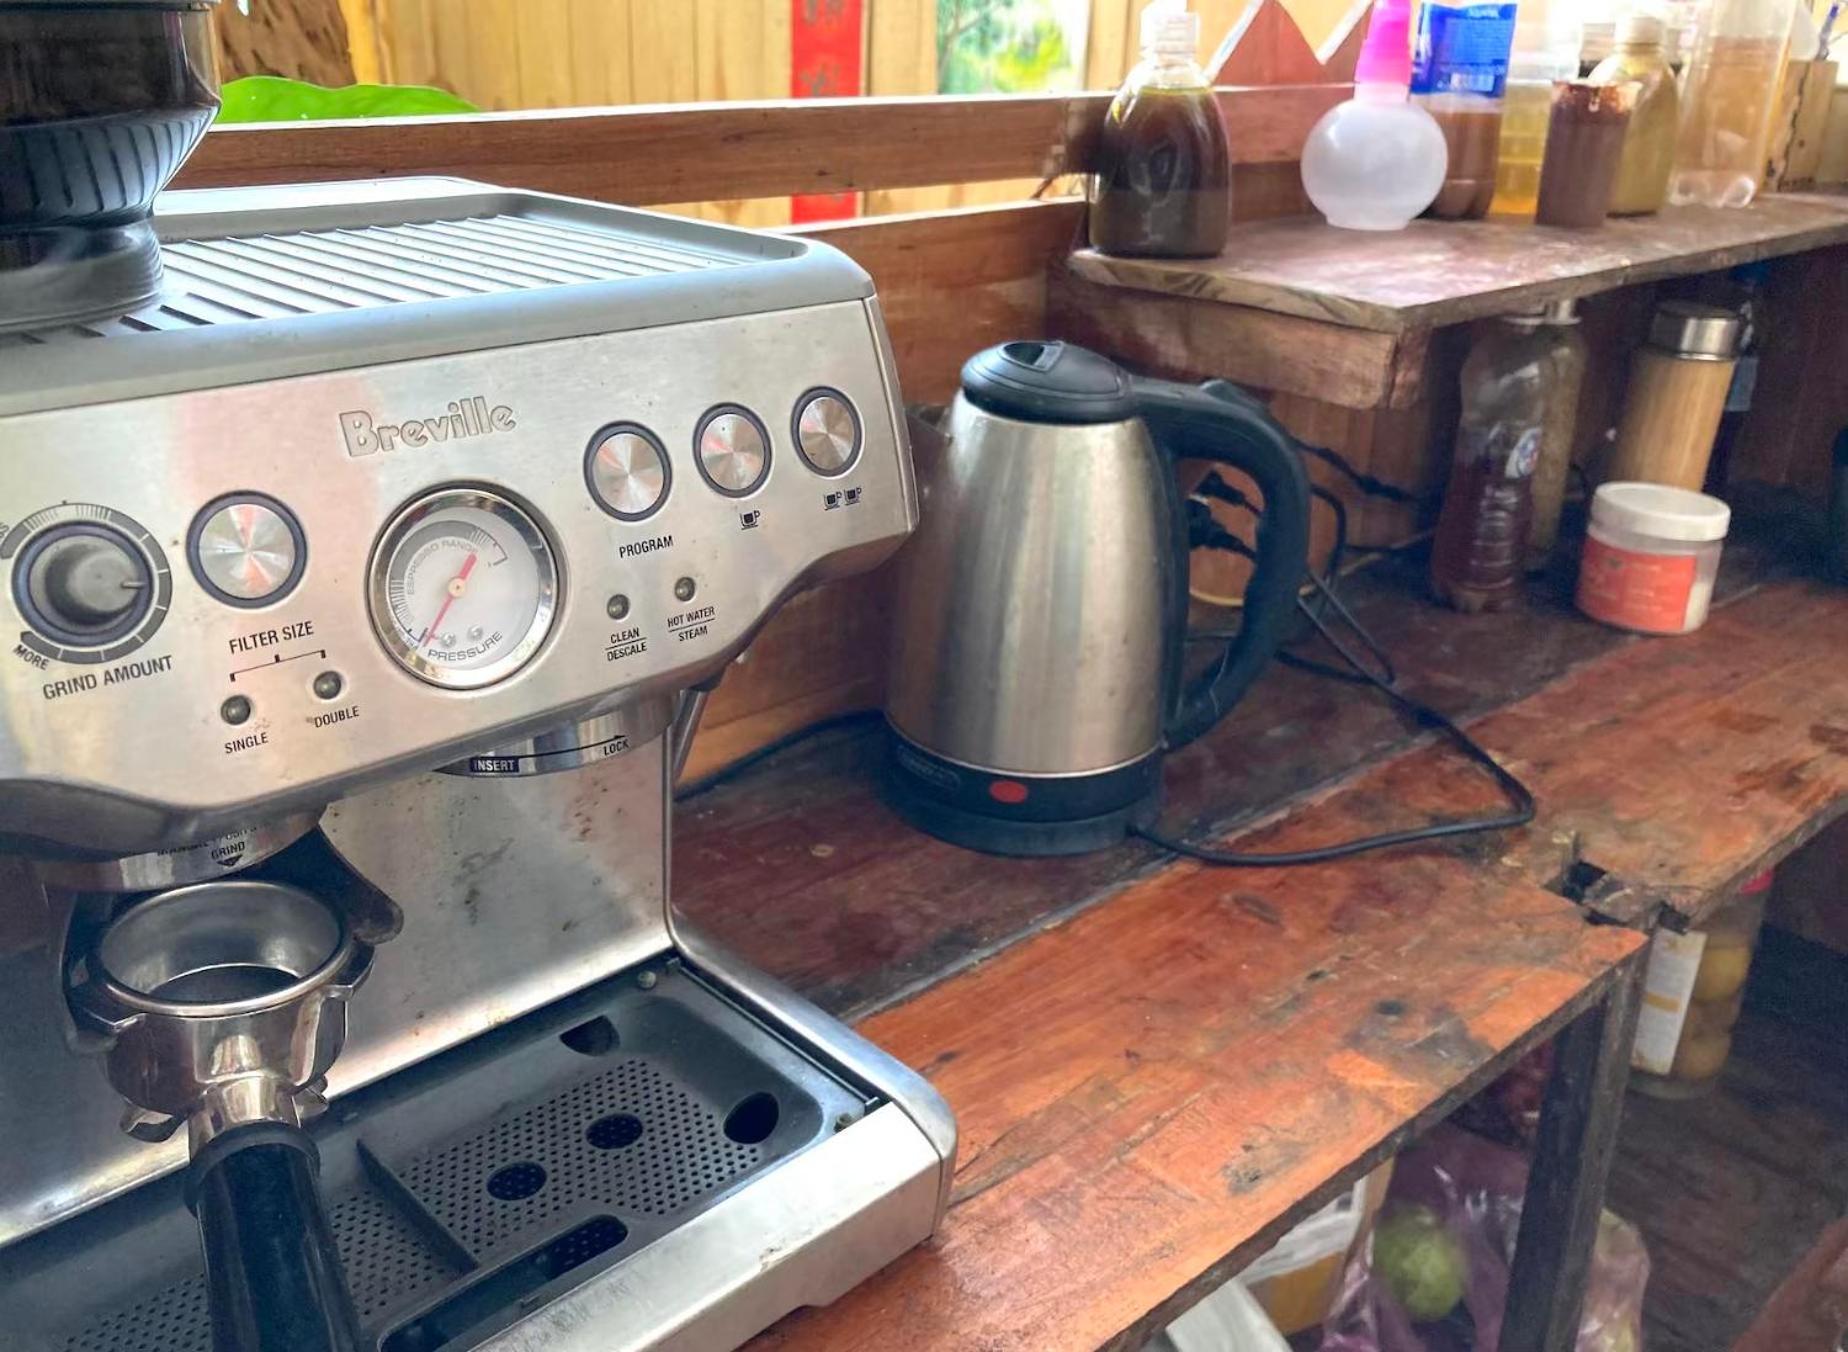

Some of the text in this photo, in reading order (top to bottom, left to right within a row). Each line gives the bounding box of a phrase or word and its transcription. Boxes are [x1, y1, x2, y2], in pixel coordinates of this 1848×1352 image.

[339, 396, 517, 457] Breville
[619, 535, 674, 558] PROGRAM
[667, 606, 716, 628] HOT WATER
[229, 620, 314, 655] FILTER SIZE
[610, 627, 640, 644] CLEAN
[678, 625, 708, 642] STEAM
[13, 644, 50, 671] MORE
[427, 631, 503, 662] PRESSURE
[607, 641, 648, 662] DESCALE
[42, 655, 173, 700] GRIND AMOUNT
[314, 705, 360, 728] DOUBLE
[224, 732, 269, 754] SINGLE
[603, 739, 630, 756] LOCK
[474, 759, 514, 771] INSERT
[211, 841, 245, 859] GRIND
